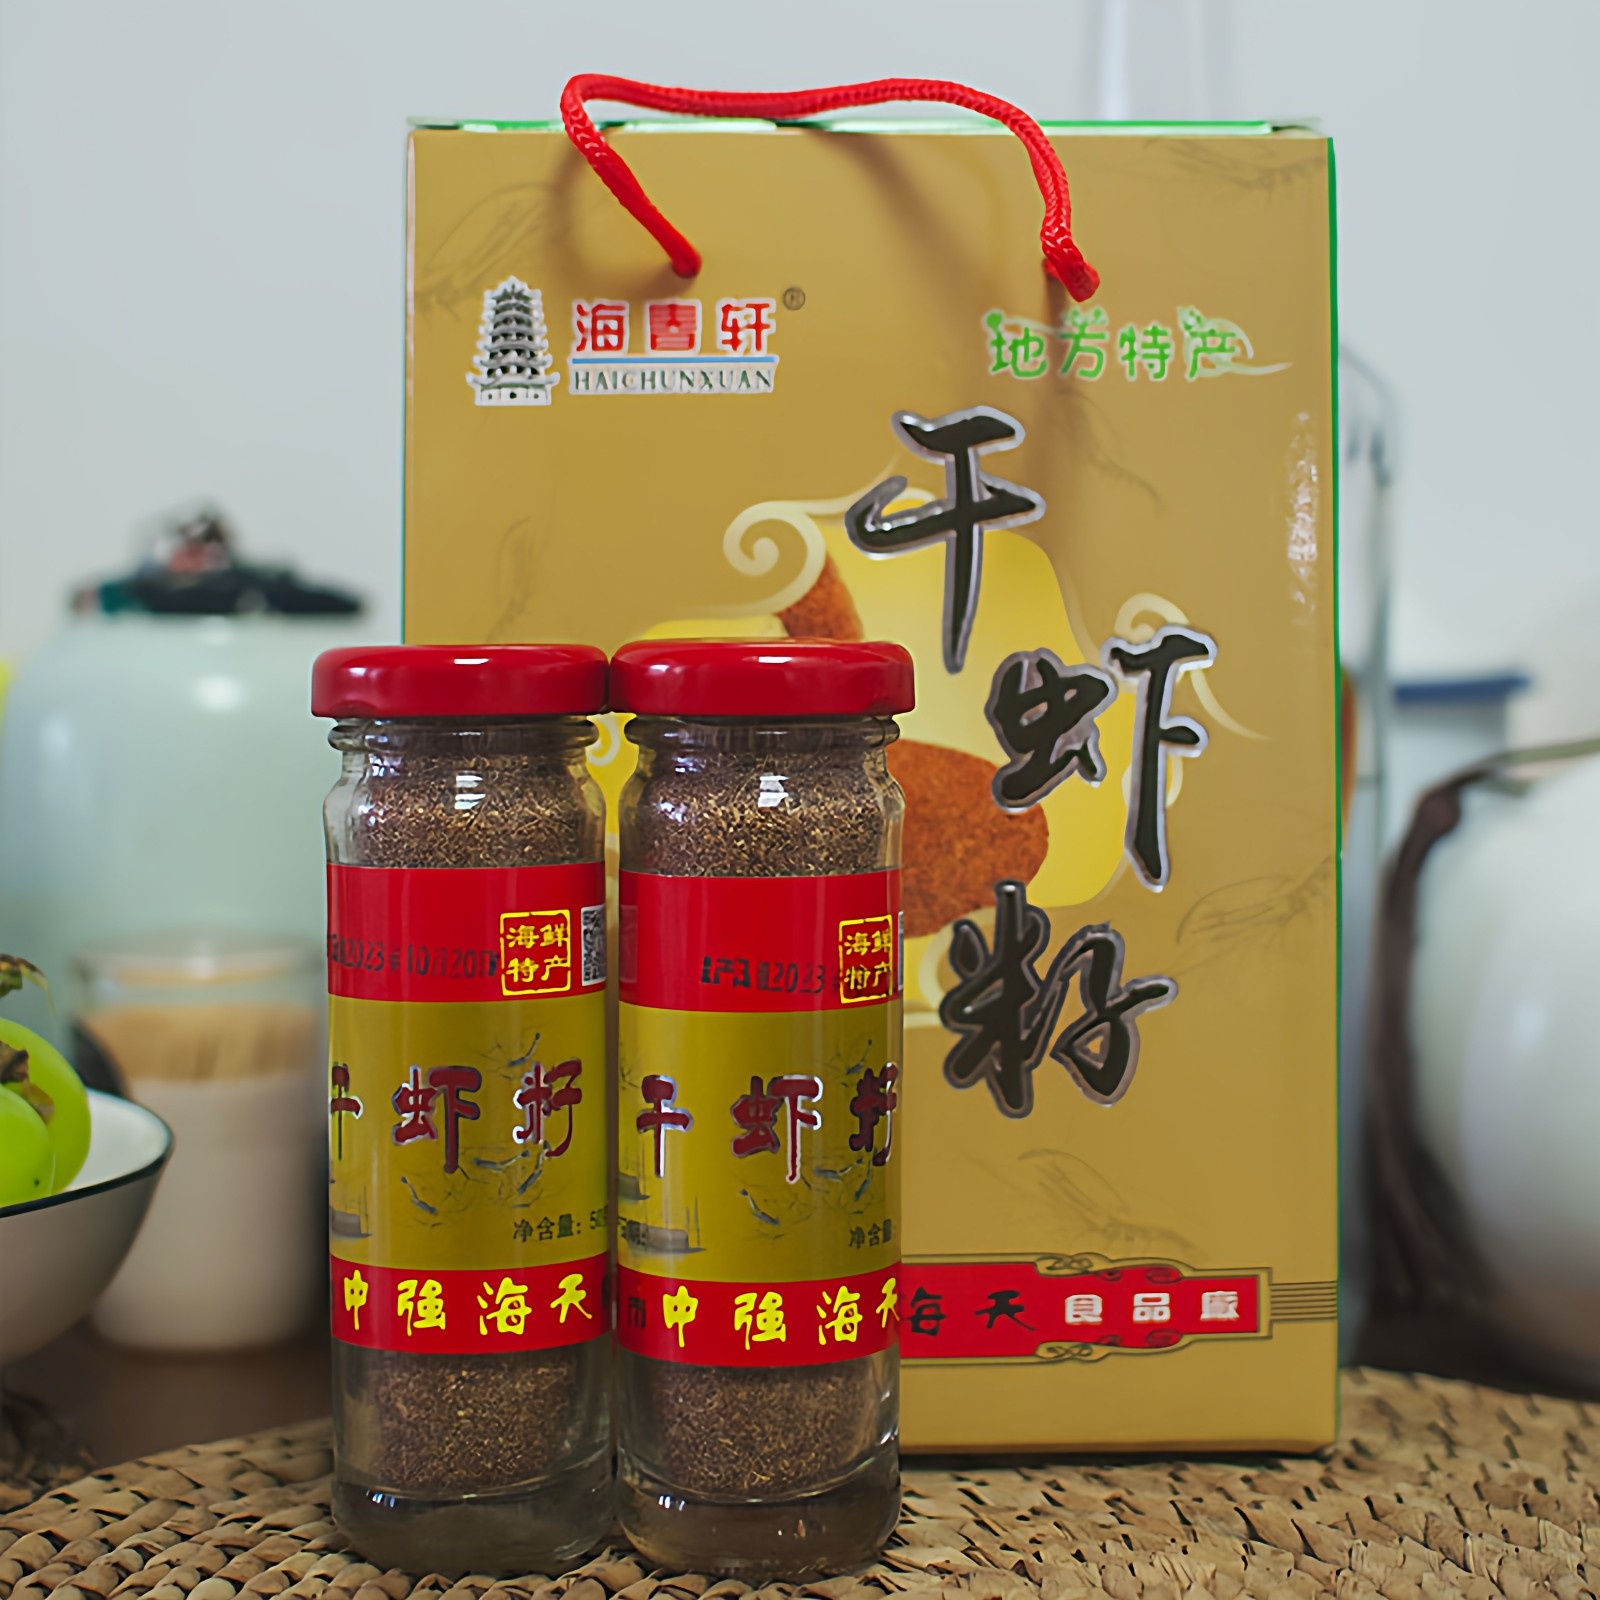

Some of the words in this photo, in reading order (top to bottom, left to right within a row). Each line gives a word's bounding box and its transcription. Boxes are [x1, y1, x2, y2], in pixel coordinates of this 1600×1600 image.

[983, 307, 1240, 381] 地方特产
[574, 369, 771, 393] HAICHUNXUAN
[506, 922, 566, 949] 海鲜
[506, 955, 568, 983] 特产
[636, 1062, 898, 1184] 干虾籽
[343, 1269, 593, 1337] 申强海天
